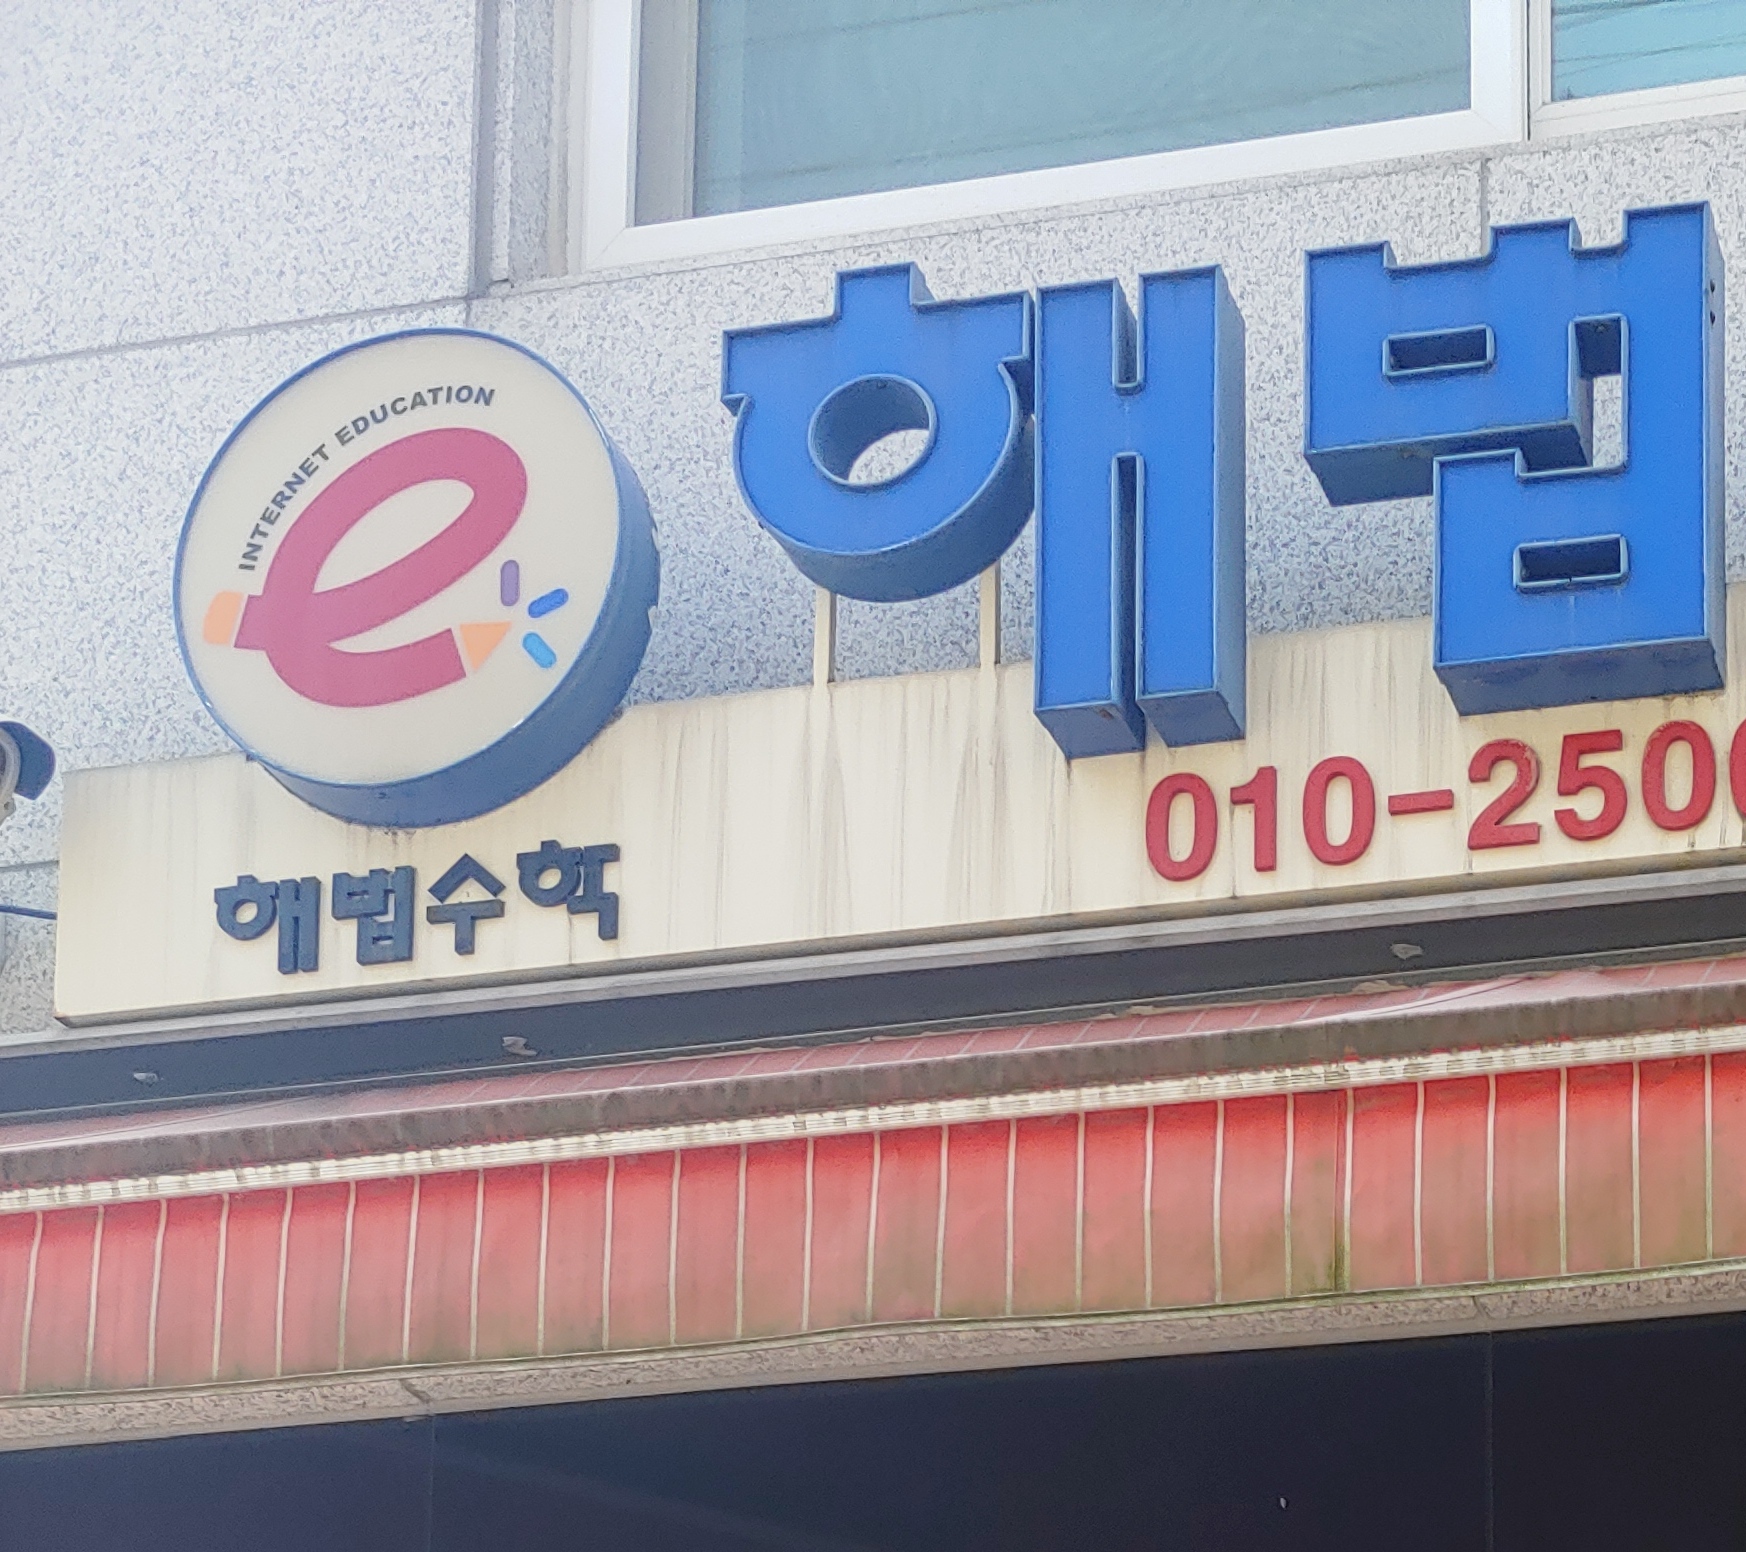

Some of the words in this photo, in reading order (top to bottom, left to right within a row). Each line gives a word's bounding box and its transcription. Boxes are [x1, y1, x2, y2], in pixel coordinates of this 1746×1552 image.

[238, 444, 330, 573] INTERNET
[334, 384, 497, 448] EDUCATION
[214, 840, 620, 974] 해법수학
